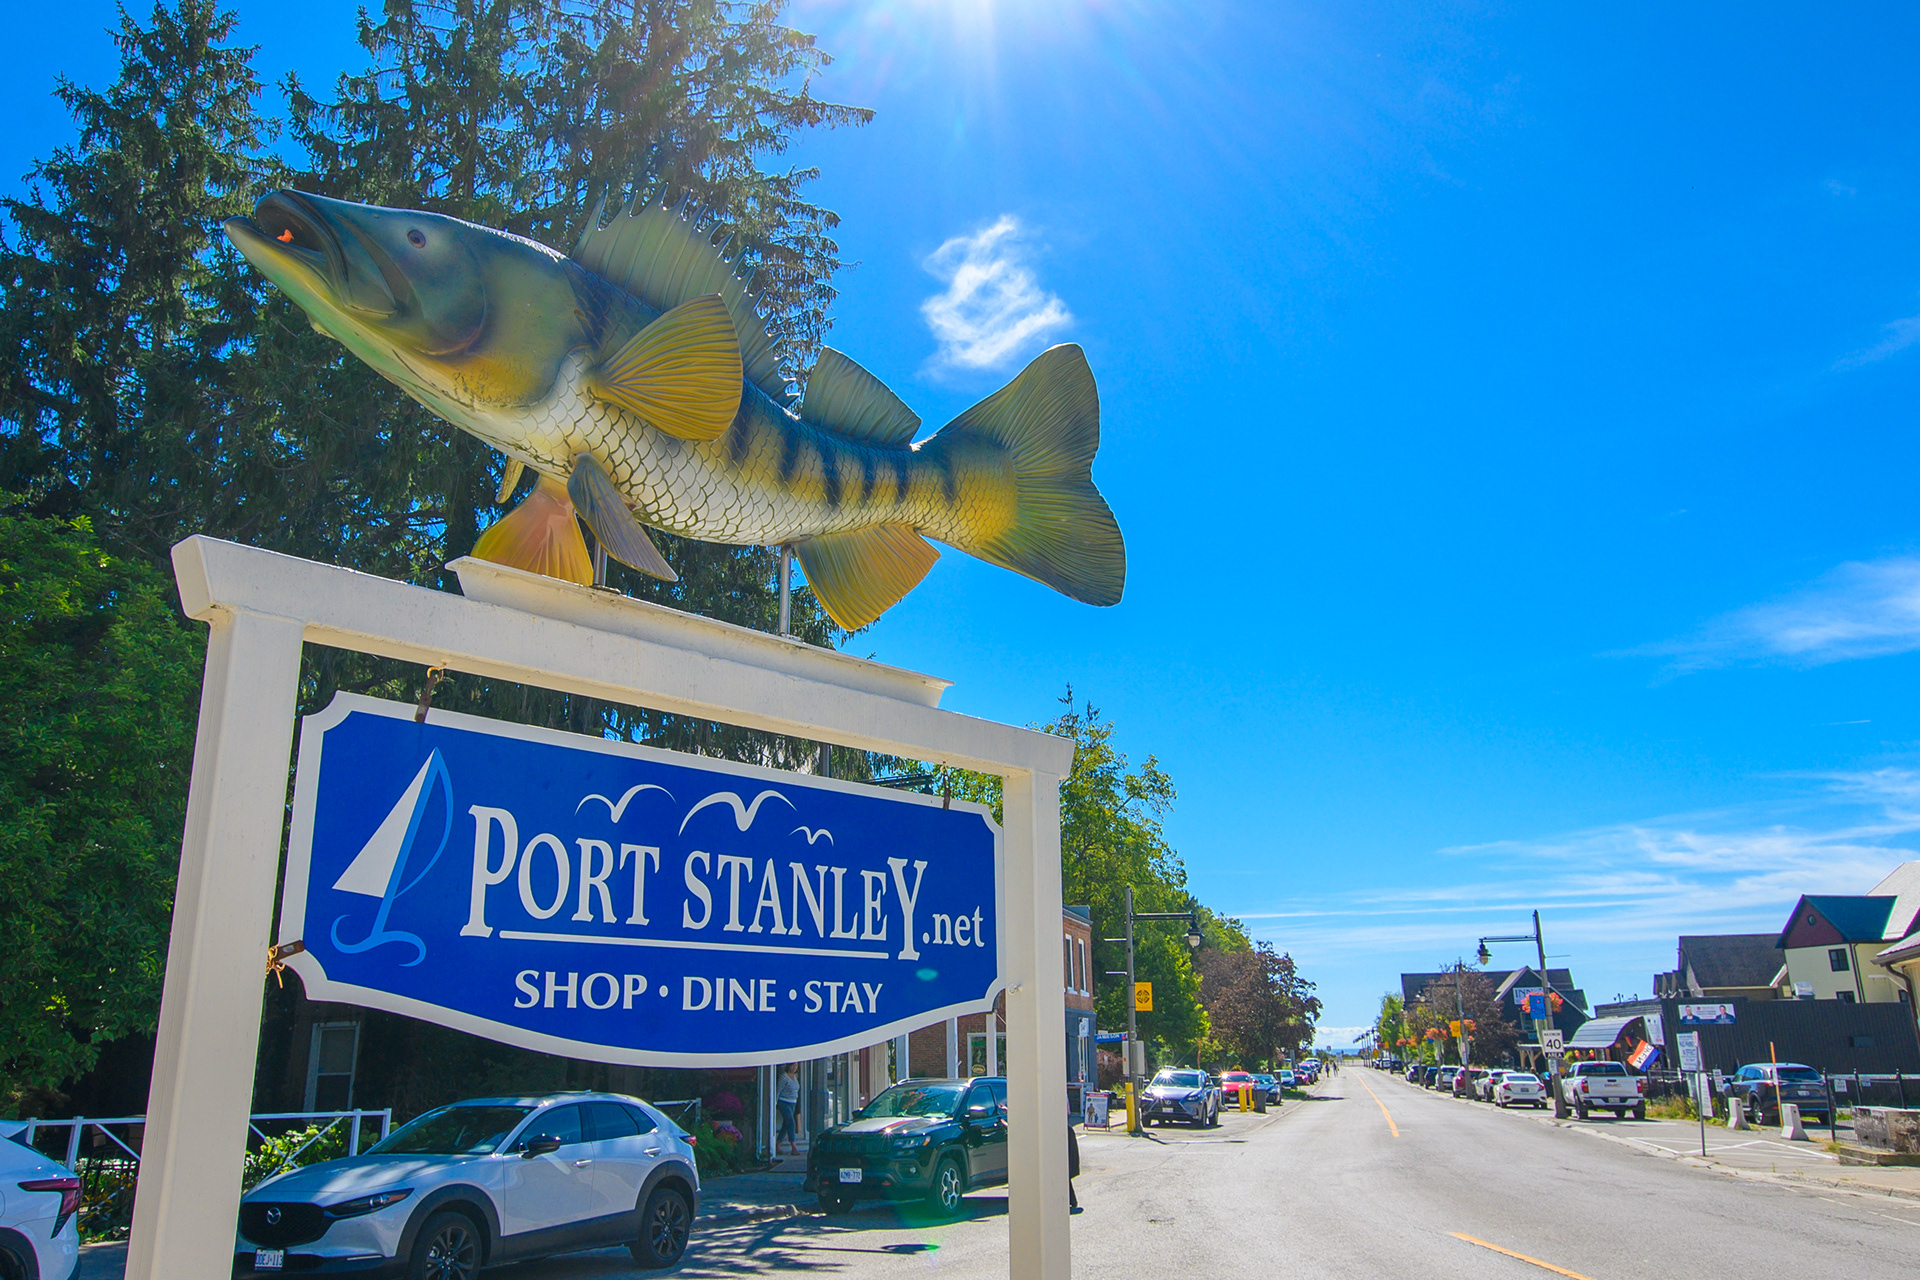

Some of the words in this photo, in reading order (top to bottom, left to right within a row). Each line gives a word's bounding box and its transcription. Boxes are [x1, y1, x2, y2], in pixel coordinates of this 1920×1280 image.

[460, 804, 661, 938] PORT
[514, 969, 648, 1010] SHOP
[682, 976, 777, 1012] DINE
[804, 980, 884, 1014] STAY
[1546, 1039, 1561, 1050] 40
